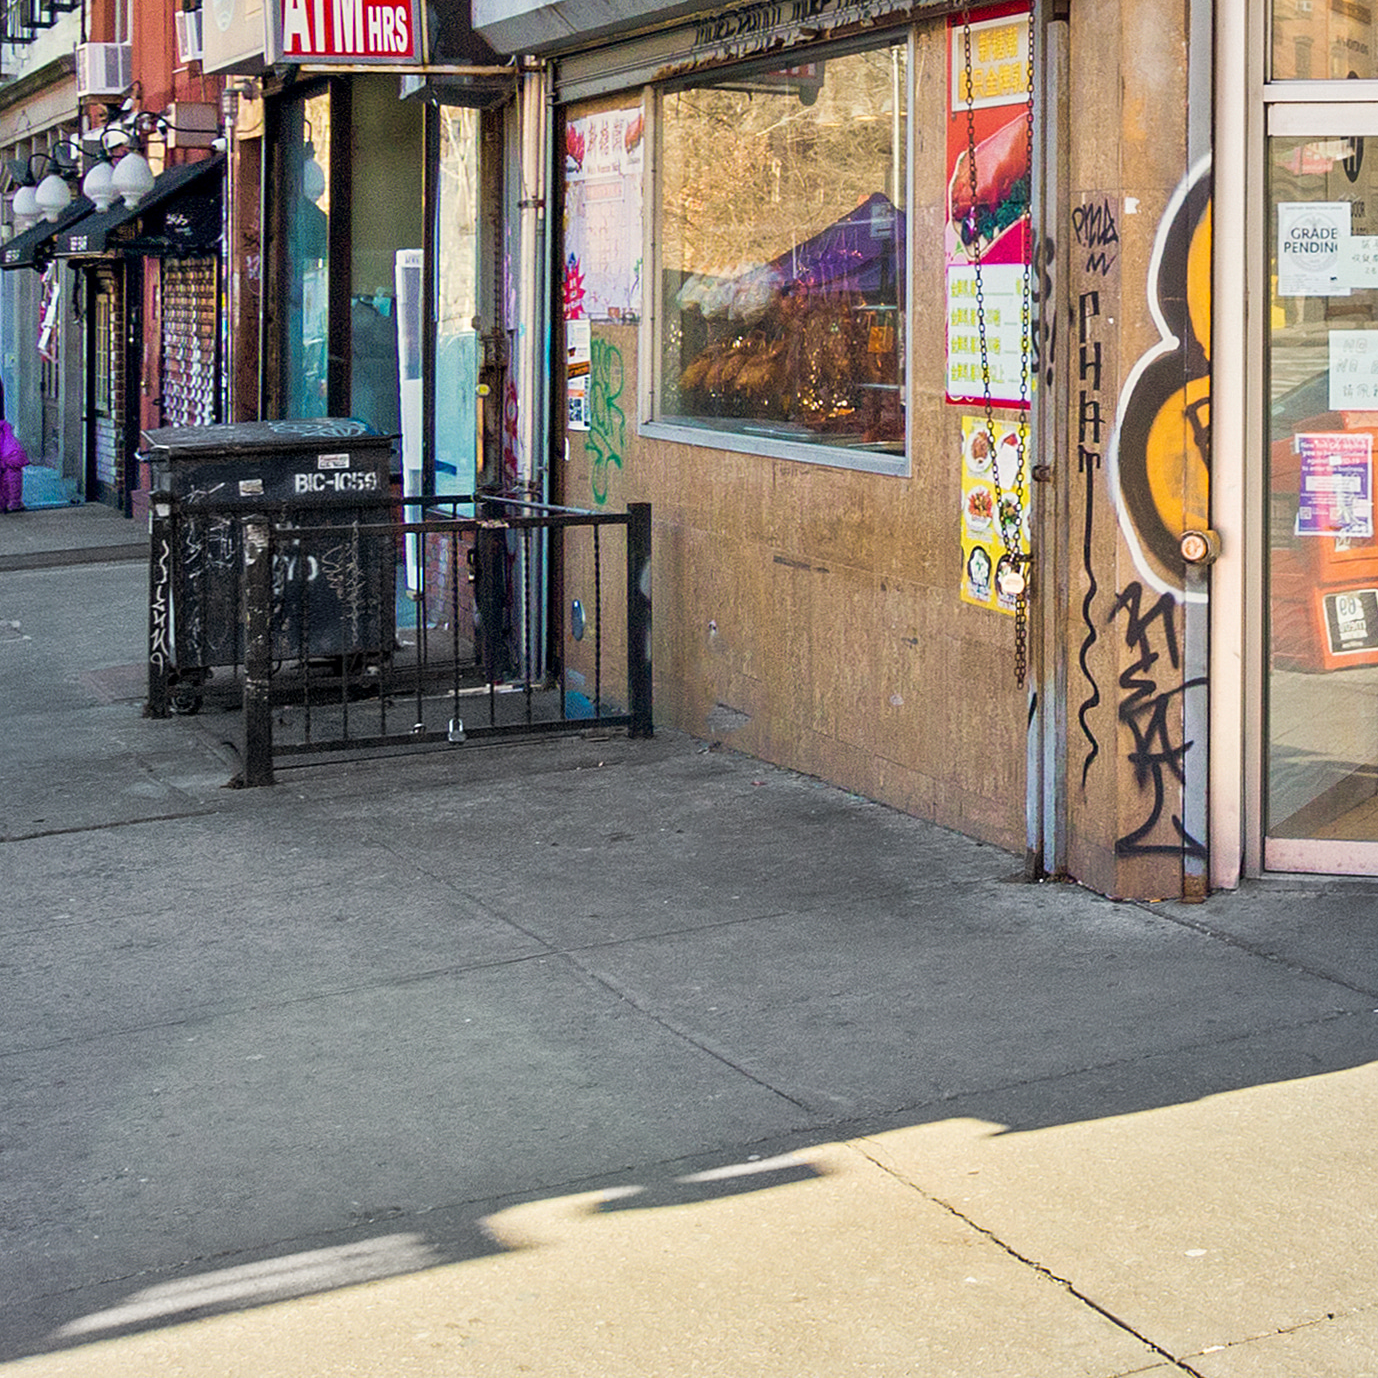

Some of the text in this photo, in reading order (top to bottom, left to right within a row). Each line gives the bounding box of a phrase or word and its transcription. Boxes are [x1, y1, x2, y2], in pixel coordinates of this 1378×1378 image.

[367, 6, 408, 53] HRS
[1290, 227, 1338, 240] GRADE
[1343, 338, 1368, 354] NO
[1336, 358, 1358, 373] NO
